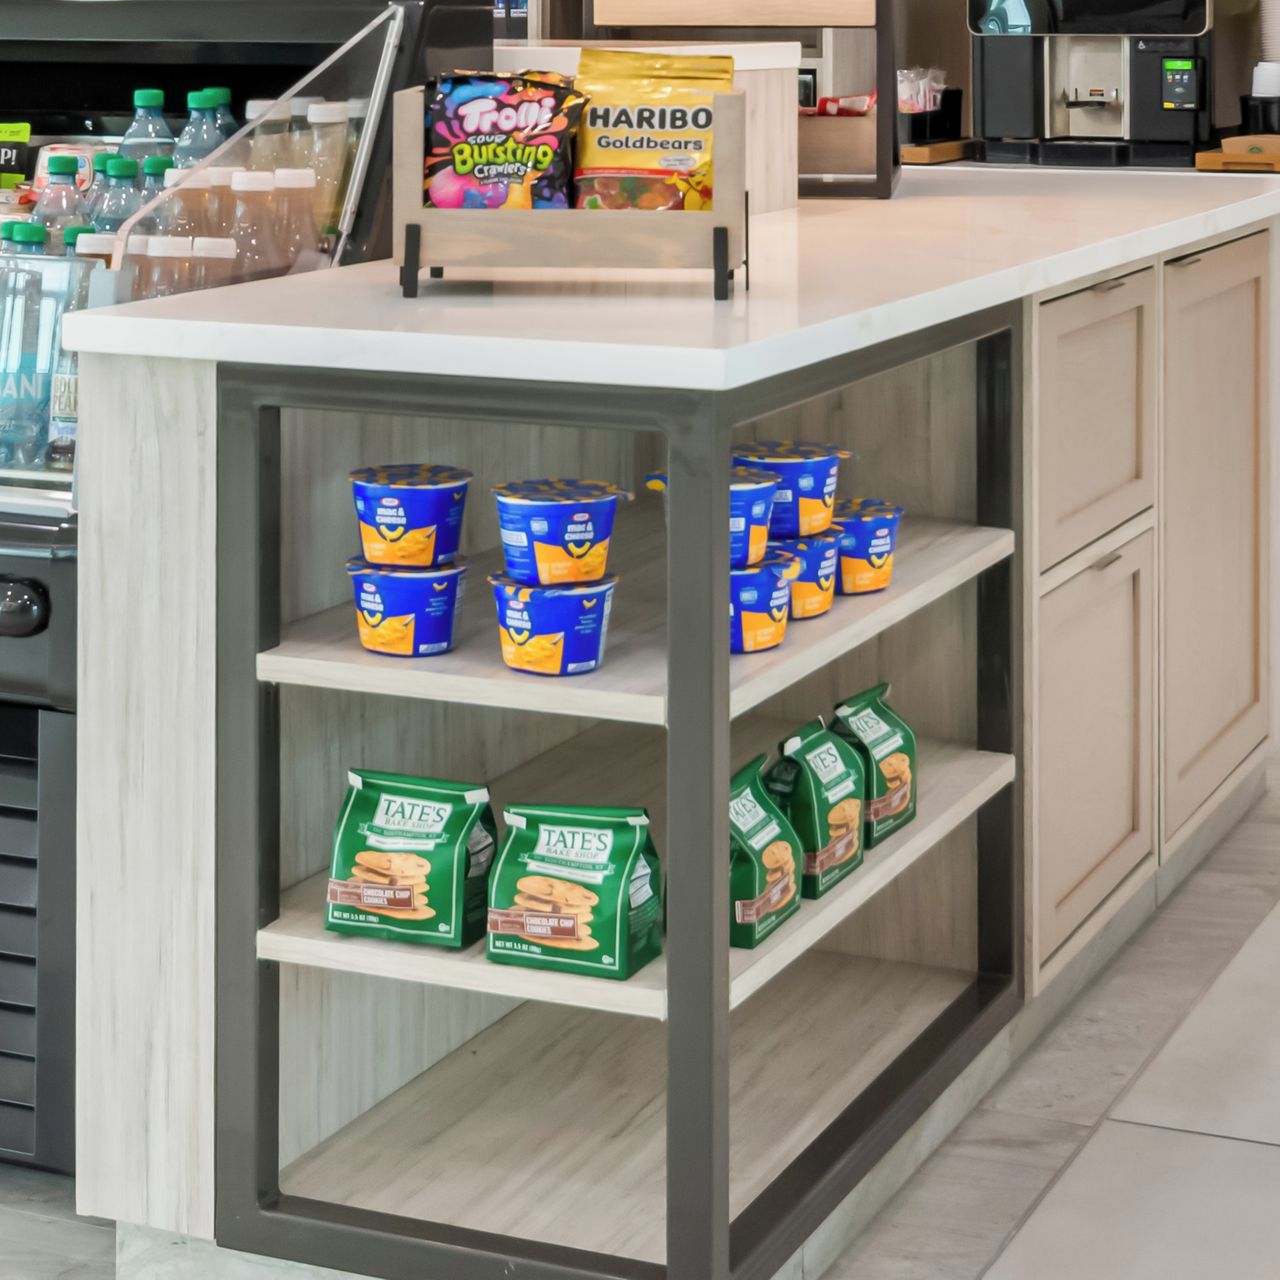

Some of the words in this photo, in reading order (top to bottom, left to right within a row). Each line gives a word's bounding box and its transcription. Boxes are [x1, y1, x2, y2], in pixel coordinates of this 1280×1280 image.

[458, 97, 555, 134] Trolli
[588, 106, 713, 130] HARIBO
[597, 135, 704, 151] Goldbears
[452, 138, 554, 175] Bursting
[383, 798, 447, 823] TATE'S
[384, 818, 407, 827] BAKE
[411, 822, 435, 830] SHOP
[543, 829, 609, 852] TATE'S
[545, 848, 571, 857] BAKE
[575, 850, 599, 859] SHOP
